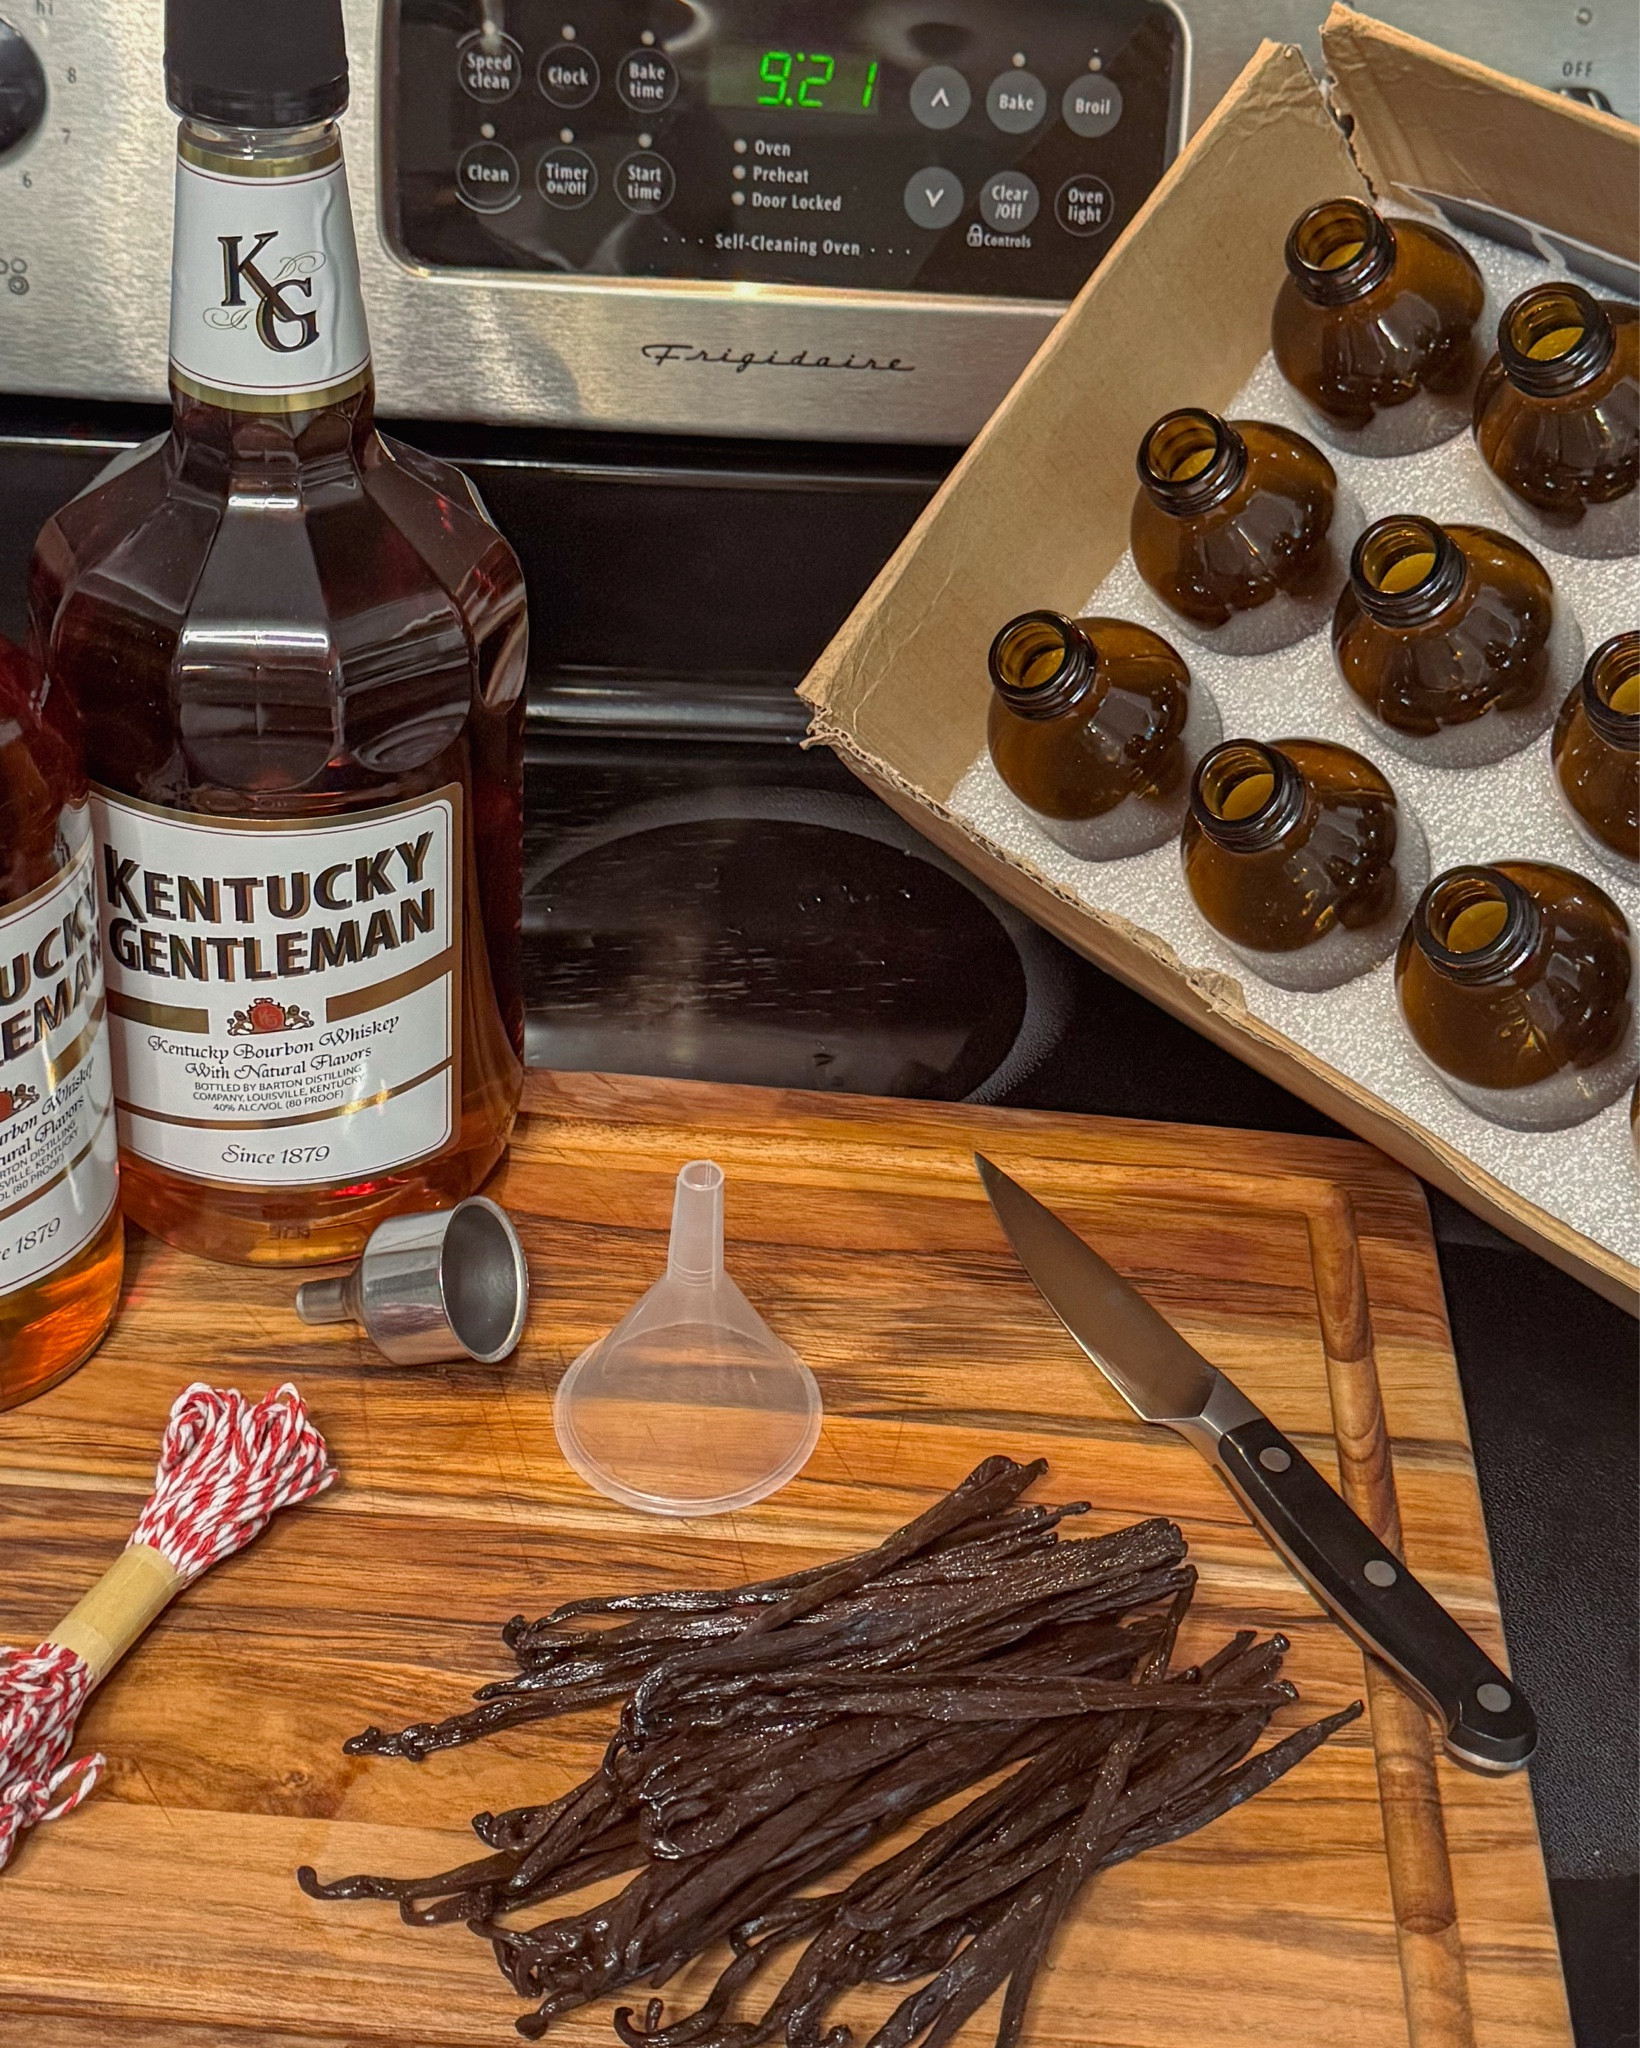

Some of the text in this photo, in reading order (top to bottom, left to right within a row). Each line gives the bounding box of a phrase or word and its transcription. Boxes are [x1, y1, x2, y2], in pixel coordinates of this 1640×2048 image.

[467, 52, 512, 72] Speed
[628, 62, 665, 80] Bake
[1562, 61, 1594, 77] OFF
[67, 67, 77, 84] 8
[468, 72, 511, 90] clean
[547, 66, 589, 86] Clock
[757, 51, 879, 108] 9:21
[628, 81, 664, 99] time
[999, 94, 1034, 112] Bake
[1075, 98, 1111, 115] Broil
[61, 127, 71, 144] 7
[754, 140, 791, 157] Oven
[467, 164, 510, 182] Clean
[545, 162, 589, 180] Timer
[627, 164, 662, 182] Start
[753, 165, 809, 184] Preheat
[22, 172, 32, 189] 6
[546, 179, 587, 196] On/Off
[627, 183, 662, 201] time
[752, 191, 842, 211] Door Locked
[991, 184, 1029, 202] Clear
[1068, 188, 1104, 204] Oven
[995, 203, 1023, 220] /Off
[1068, 204, 1102, 225] light
[715, 233, 860, 257] Self-Cleaning Oven
[984, 234, 1032, 249] Controls
[641, 344, 916, 373] Frigidaire
[103, 830, 434, 924] KENTUCKY
[108, 887, 436, 982] GENTLEMAN
[147, 1015, 400, 1064] Kentucky Bourbon Whiskey
[185, 1047, 372, 1080] With Natural Flavors
[195, 1064, 362, 1093] BOTTLED BY BARTON DISTILLING
[309, 1074, 366, 1094] KENTUCKY
[213, 1089, 345, 1112] 40% ALC/VOL (80 PROOF)
[221, 1144, 331, 1165] Since 1879
[15, 1217, 60, 1254] 1879
